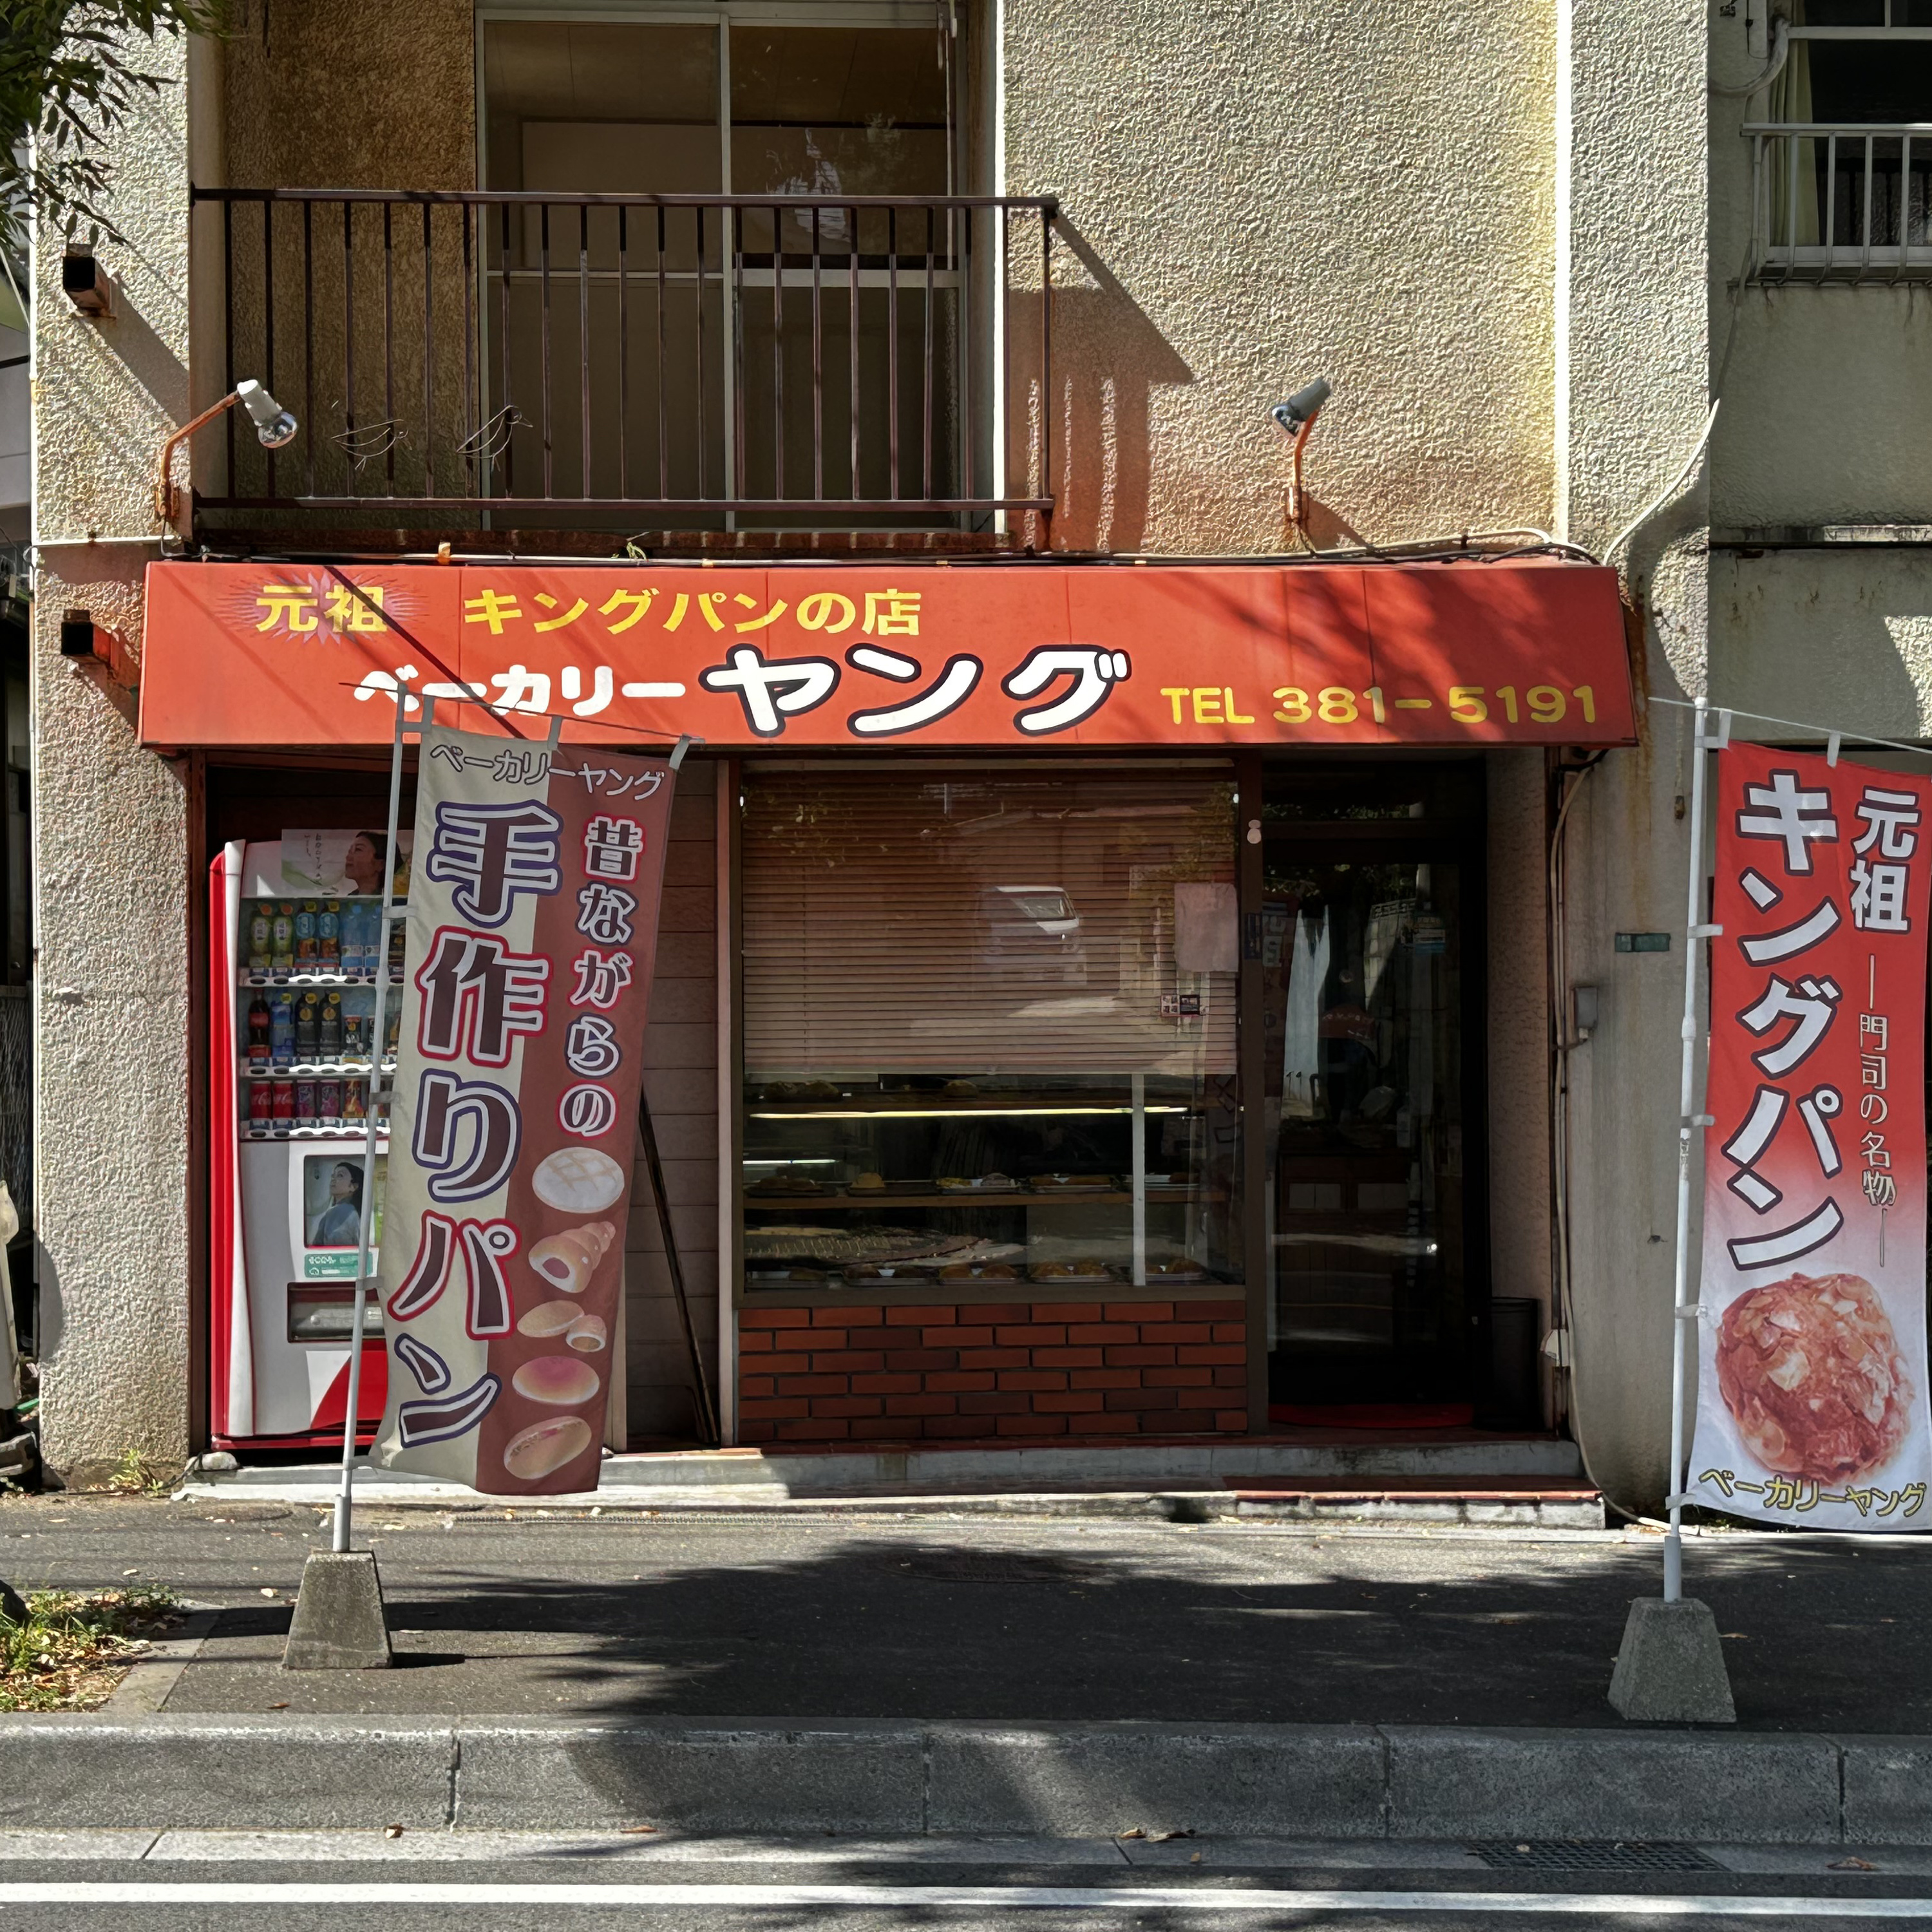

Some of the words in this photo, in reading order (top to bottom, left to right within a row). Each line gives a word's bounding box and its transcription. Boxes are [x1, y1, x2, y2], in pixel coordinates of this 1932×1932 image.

[256, 584, 388, 634] 元祖
[464, 588, 922, 636] キングパンの店
[1160, 687, 1255, 724] TEL
[1273, 685, 1596, 724] 381-5191
[430, 744, 665, 800] ベーカリーヤング
[1850, 785, 1922, 934] 元祖
[556, 812, 644, 1140] 昔ながらの
[1721, 769, 1844, 1271] キングパン
[388, 799, 564, 1448] 手作りパン
[1698, 1468, 1927, 1517] ベーカリーヤング
